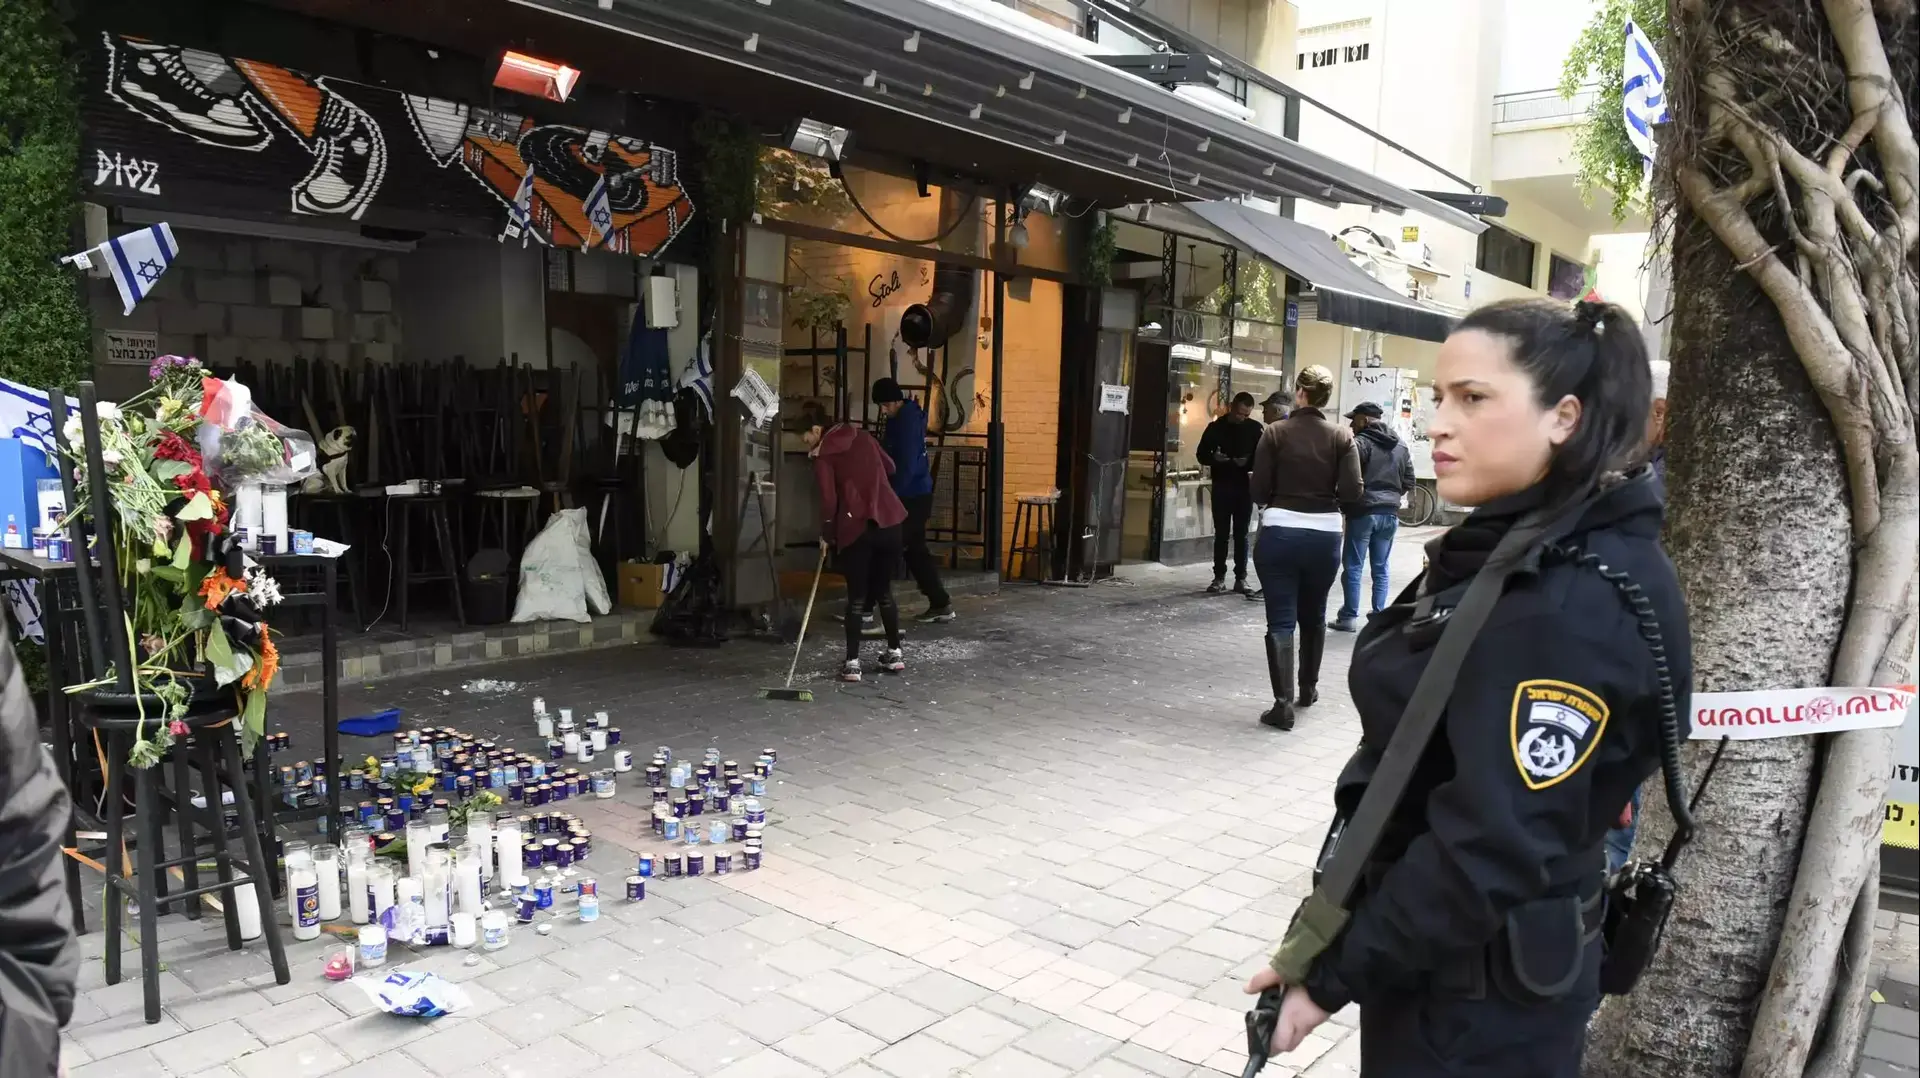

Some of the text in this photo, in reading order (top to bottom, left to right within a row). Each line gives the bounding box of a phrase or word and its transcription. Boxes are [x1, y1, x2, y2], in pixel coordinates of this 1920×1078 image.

[869, 270, 901, 307] Stoli
[127, 337, 156, 348] זהירות!
[109, 348, 156, 360] כלב בחצר
[1697, 705, 1805, 726] משטרת
